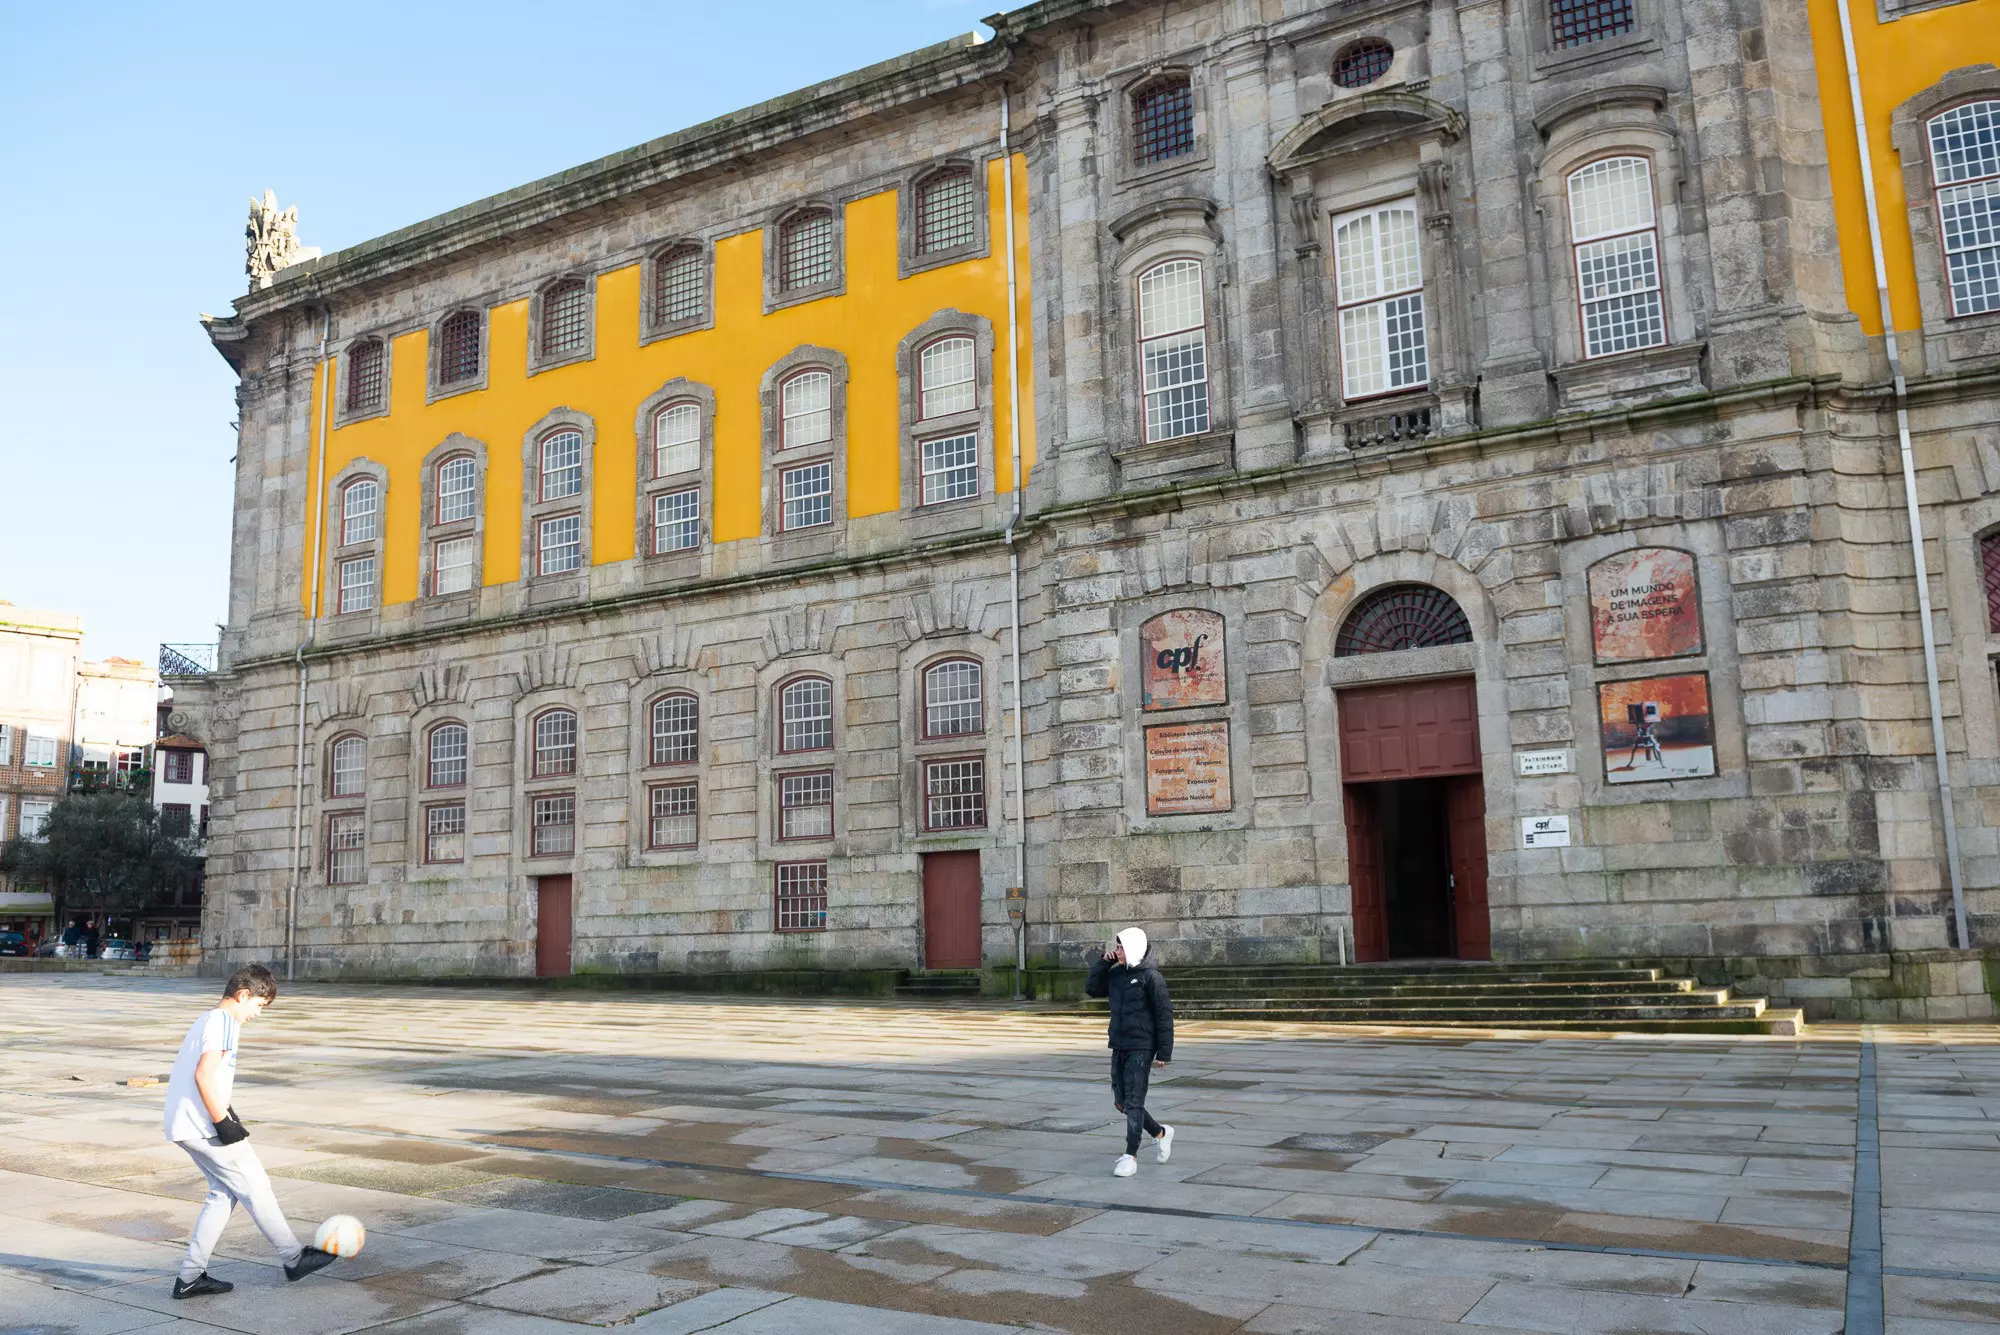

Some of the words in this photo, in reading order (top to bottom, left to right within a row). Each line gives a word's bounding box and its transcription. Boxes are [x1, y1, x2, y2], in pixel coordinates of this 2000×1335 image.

[1611, 588, 1629, 598] UM
[1631, 582, 1675, 595] MUNDO
[1610, 601, 1625, 611] DE
[1627, 595, 1678, 608] IMAGENS
[1617, 612, 1639, 622] SUA
[1641, 607, 1684, 620] ESPERA
[1157, 633, 1208, 673] cpf
[1155, 766, 1185, 775] Fotografia
[1156, 795, 1189, 803] Monumento
